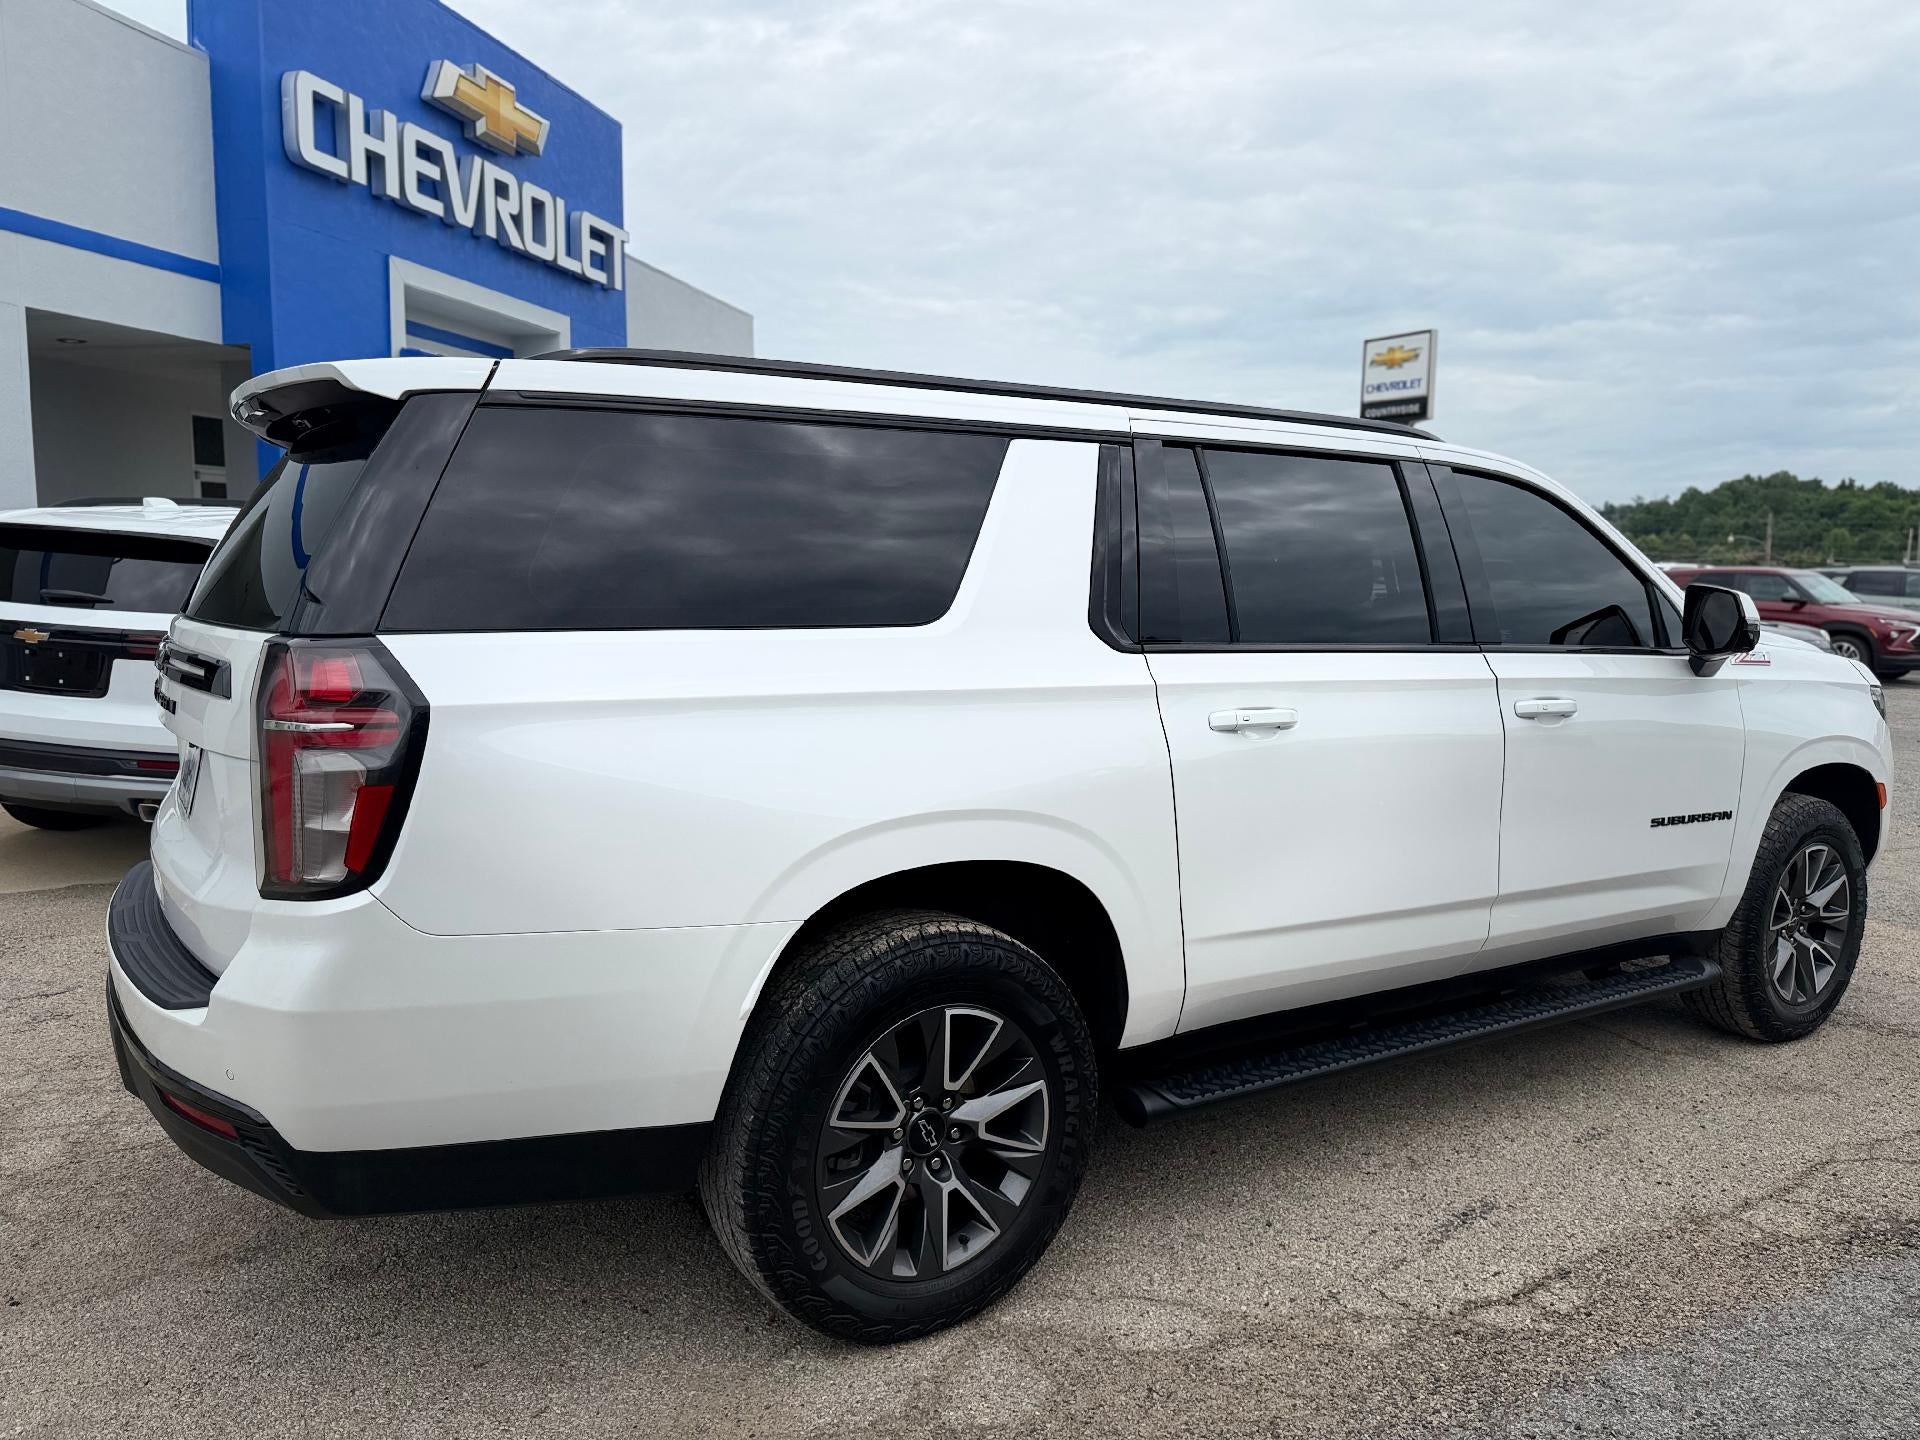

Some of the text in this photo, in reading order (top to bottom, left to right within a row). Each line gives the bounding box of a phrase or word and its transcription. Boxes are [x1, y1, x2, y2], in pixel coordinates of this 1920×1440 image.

[281, 70, 630, 291] CHEVROLET
[1365, 378, 1422, 394] CHEVROLET
[1650, 810, 1732, 828] SUBURBAN
